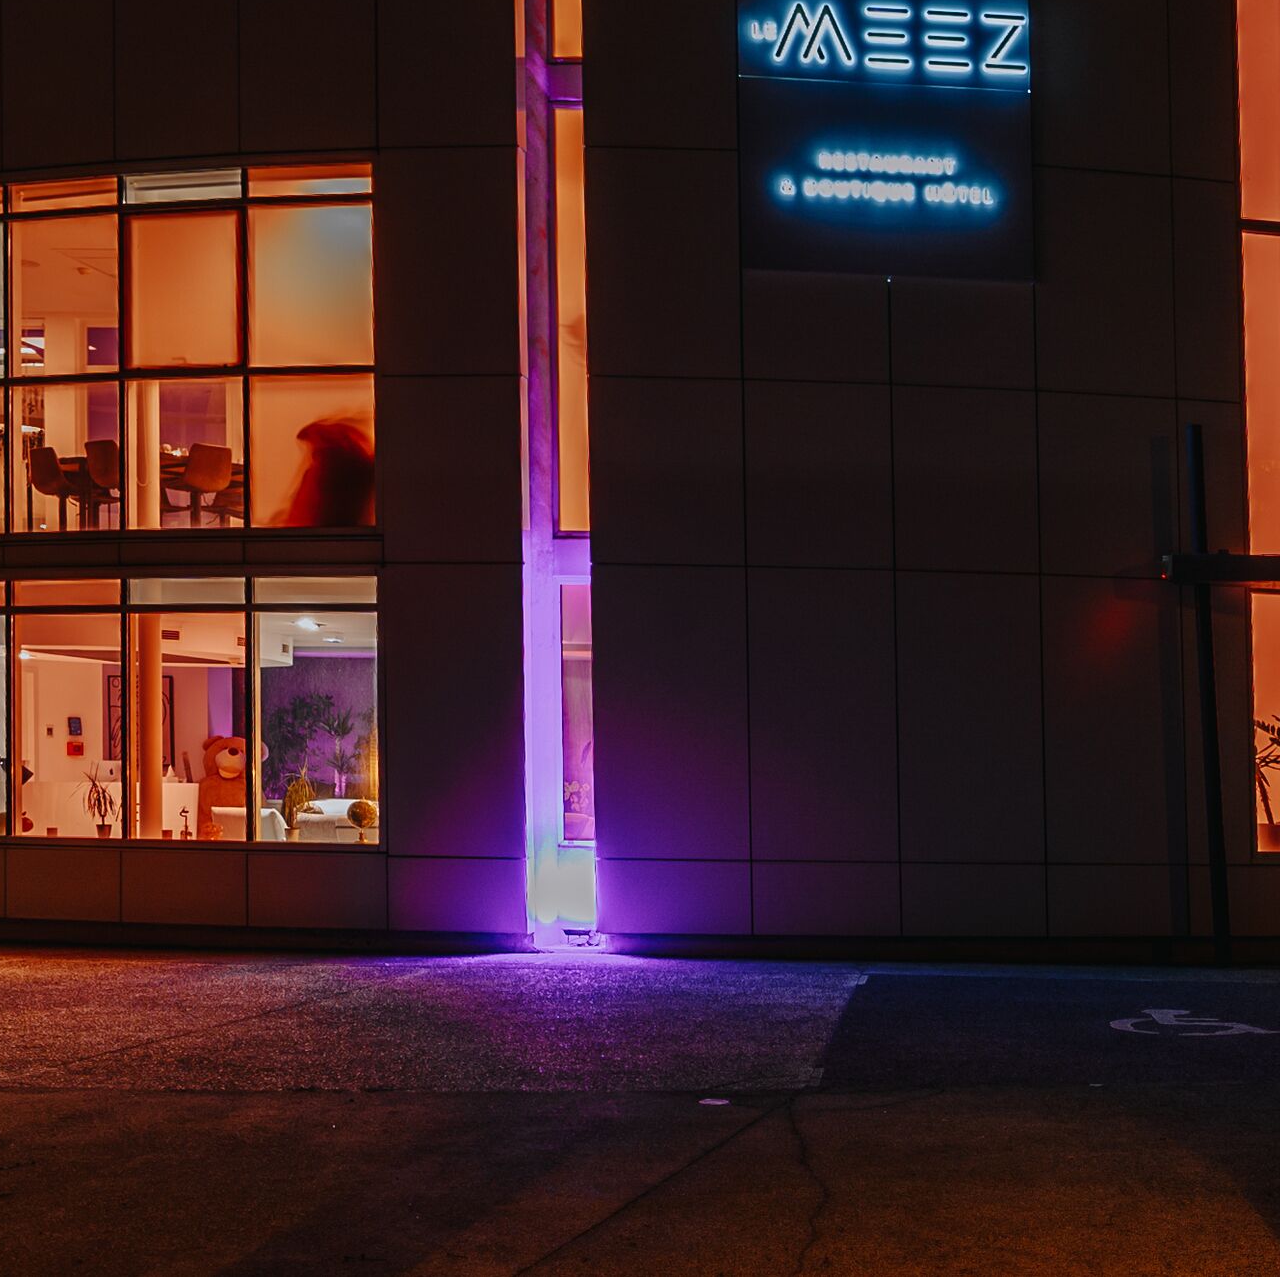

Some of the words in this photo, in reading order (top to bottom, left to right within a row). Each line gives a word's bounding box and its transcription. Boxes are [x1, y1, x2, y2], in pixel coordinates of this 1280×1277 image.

[751, 20, 778, 42] LE
[774, 2, 1028, 75] MEEZ
[779, 178, 797, 197] &
